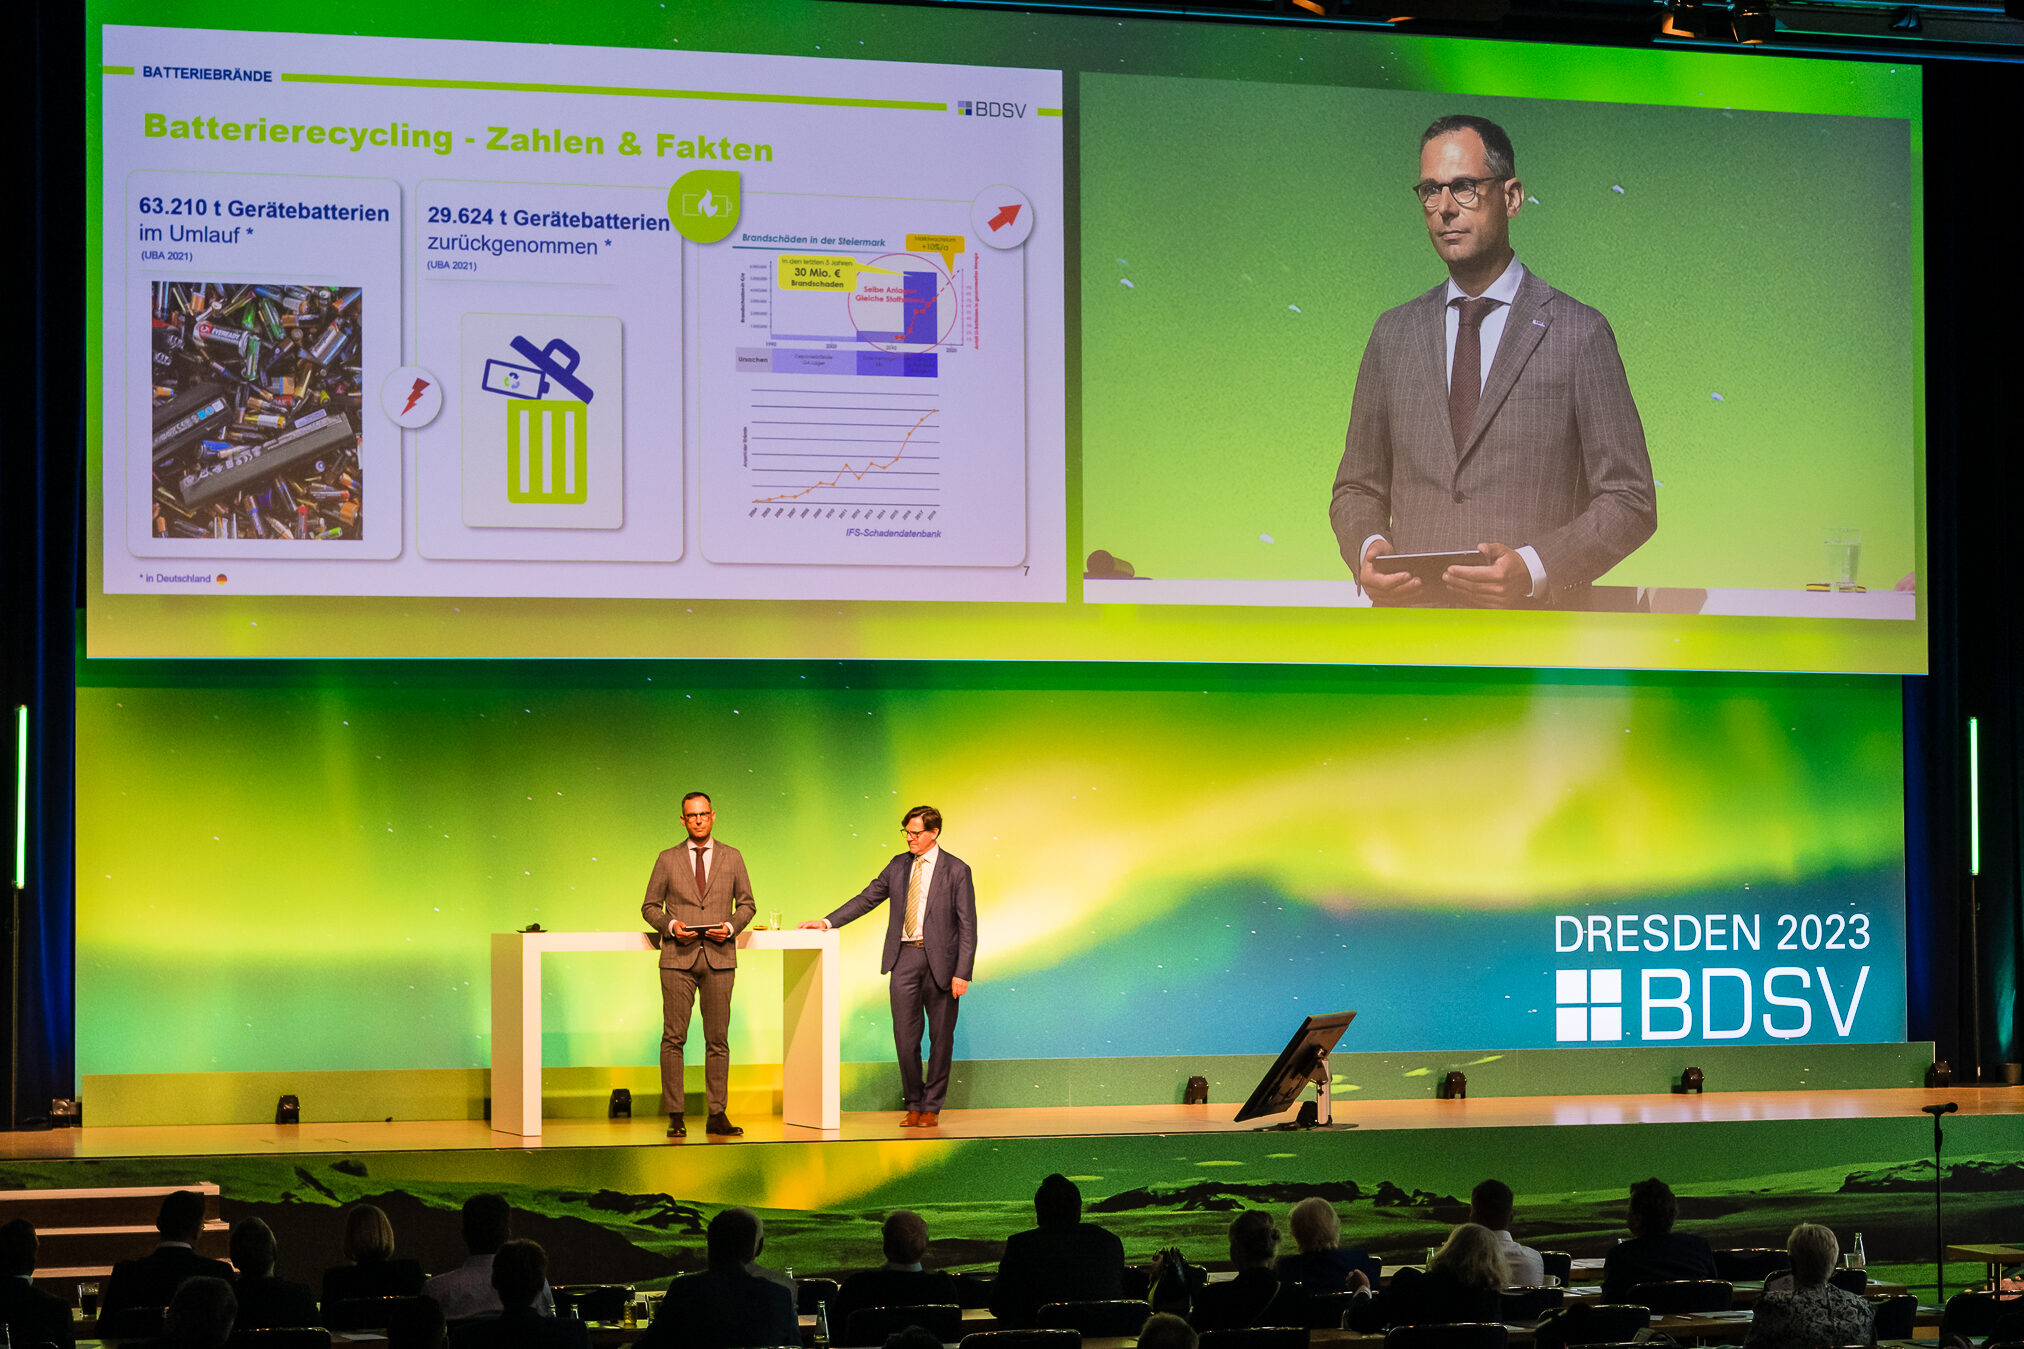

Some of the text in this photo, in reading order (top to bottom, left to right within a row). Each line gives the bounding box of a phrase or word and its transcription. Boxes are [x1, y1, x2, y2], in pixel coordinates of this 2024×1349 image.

[143, 66, 272, 82] BATTERIEBRÄNDE
[976, 101, 1026, 118] BDSV
[144, 113, 452, 155] Batterierecycling
[486, 126, 604, 154] Zahlen
[618, 131, 643, 156] &
[657, 133, 772, 162] Fakten
[140, 197, 389, 221] 63.210 t Gerätebatterien
[428, 206, 671, 231] 29.624 t Gerätebatterien
[140, 224, 162, 241] im
[170, 225, 240, 243] Umlauf
[743, 234, 807, 243] Brandschäden
[838, 237, 885, 246] Steiermark
[428, 234, 597, 256] zurückgenommen
[141, 251, 193, 262] (UBA 2021)
[427, 261, 477, 272] (UBA 2021)
[794, 267, 841, 278] 30 Mio. €
[846, 528, 941, 537] IFS-Schadendatenbank
[146, 574, 154, 582] in
[157, 574, 211, 583] Deutschland
[1023, 565, 1030, 576] 7
[1553, 912, 1872, 954] DRESDEN 2023
[1640, 964, 1872, 1042] BDSV
